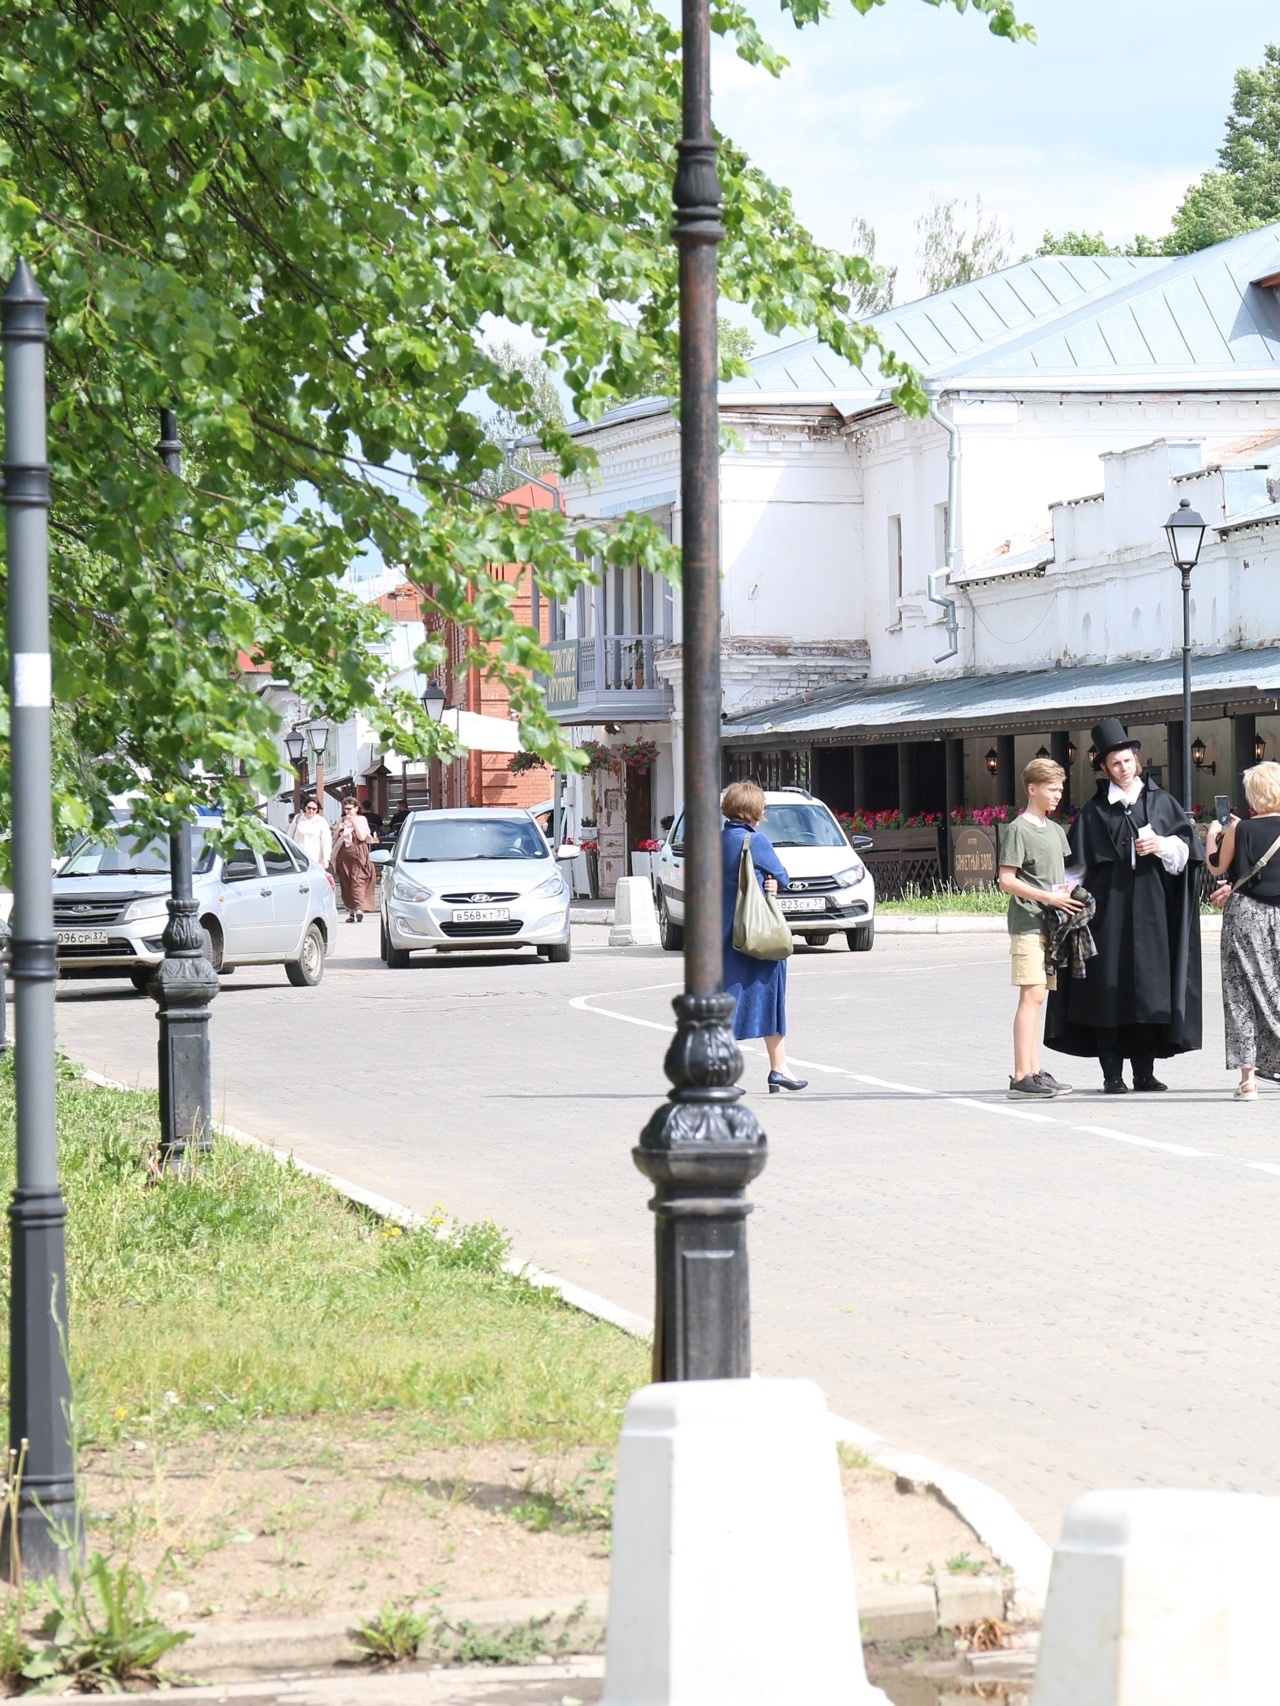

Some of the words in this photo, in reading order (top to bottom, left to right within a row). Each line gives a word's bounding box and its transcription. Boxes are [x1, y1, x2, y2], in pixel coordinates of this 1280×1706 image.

[781, 899, 811, 909] 823СХ
[814, 898, 822, 906] 37
[456, 911, 494, 921] В568КТ
[497, 909, 506, 917] 37
[57, 932, 91, 944] 096СР
[93, 931, 103, 940] 37
